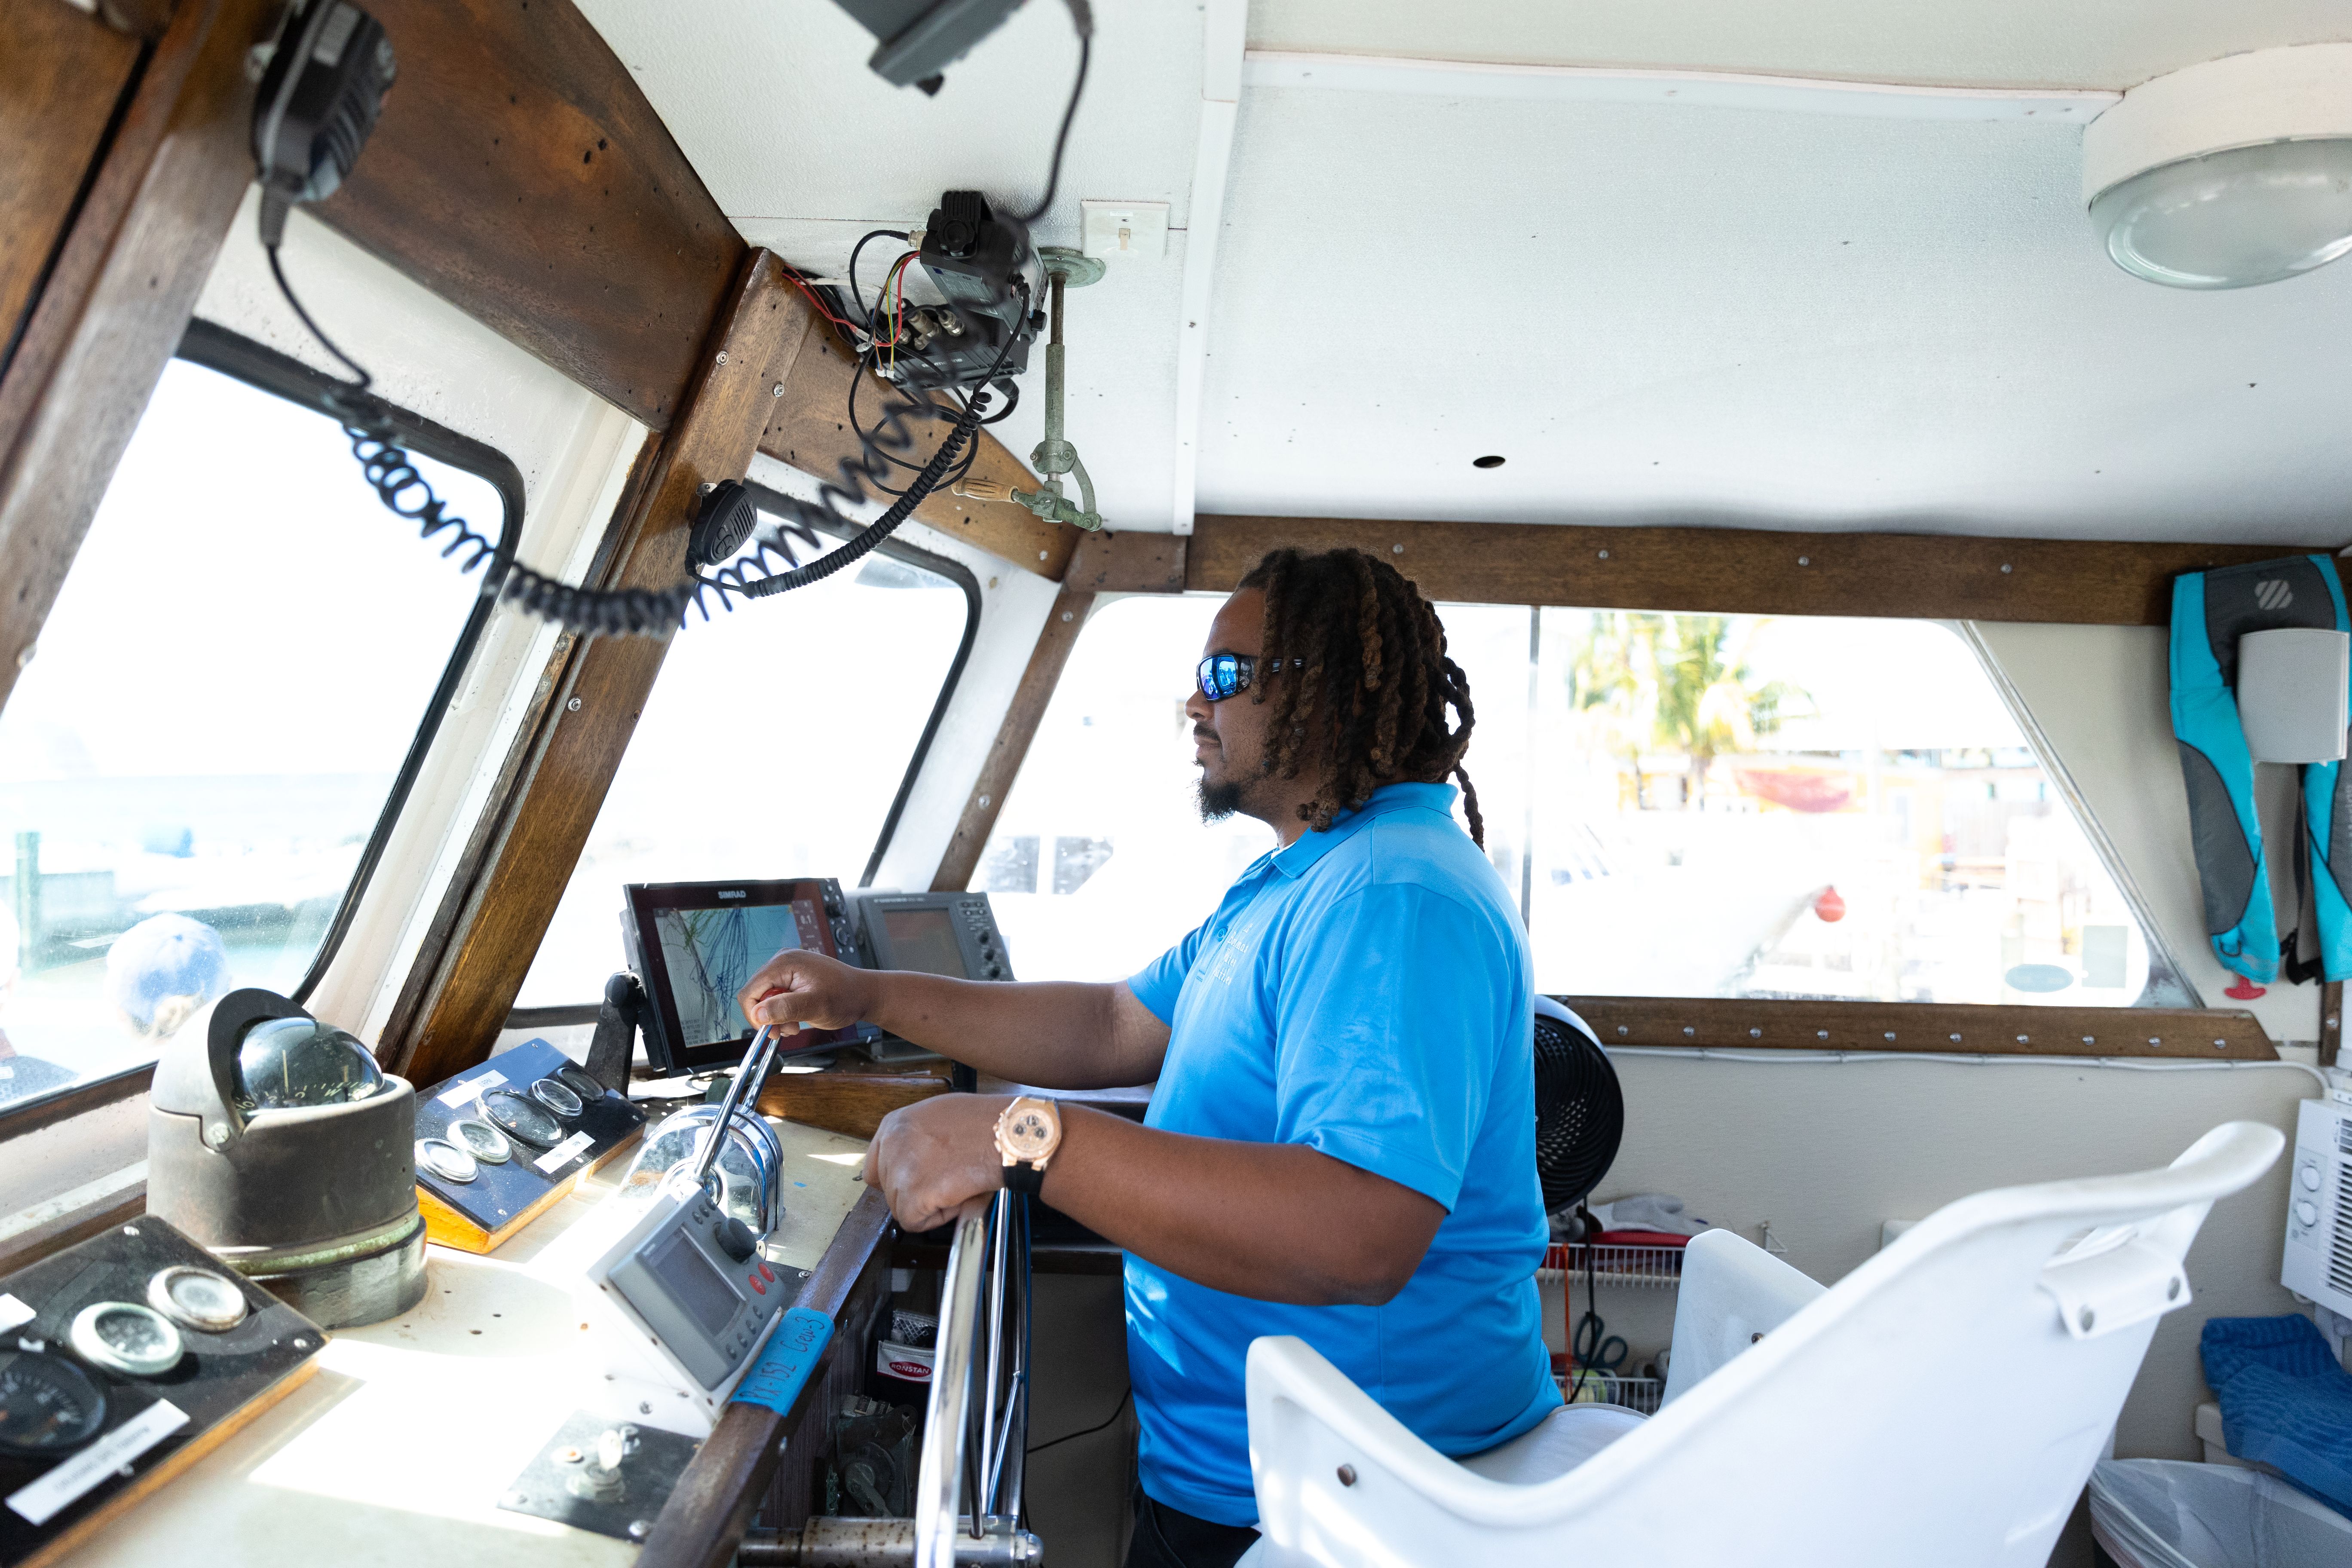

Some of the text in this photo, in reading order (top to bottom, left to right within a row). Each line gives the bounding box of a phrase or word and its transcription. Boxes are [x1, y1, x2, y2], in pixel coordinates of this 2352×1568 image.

[718, 890, 746, 899] SIMRAD
[780, 1317, 825, 1352] Crew-3
[891, 1363, 929, 1374] RONSTAN
